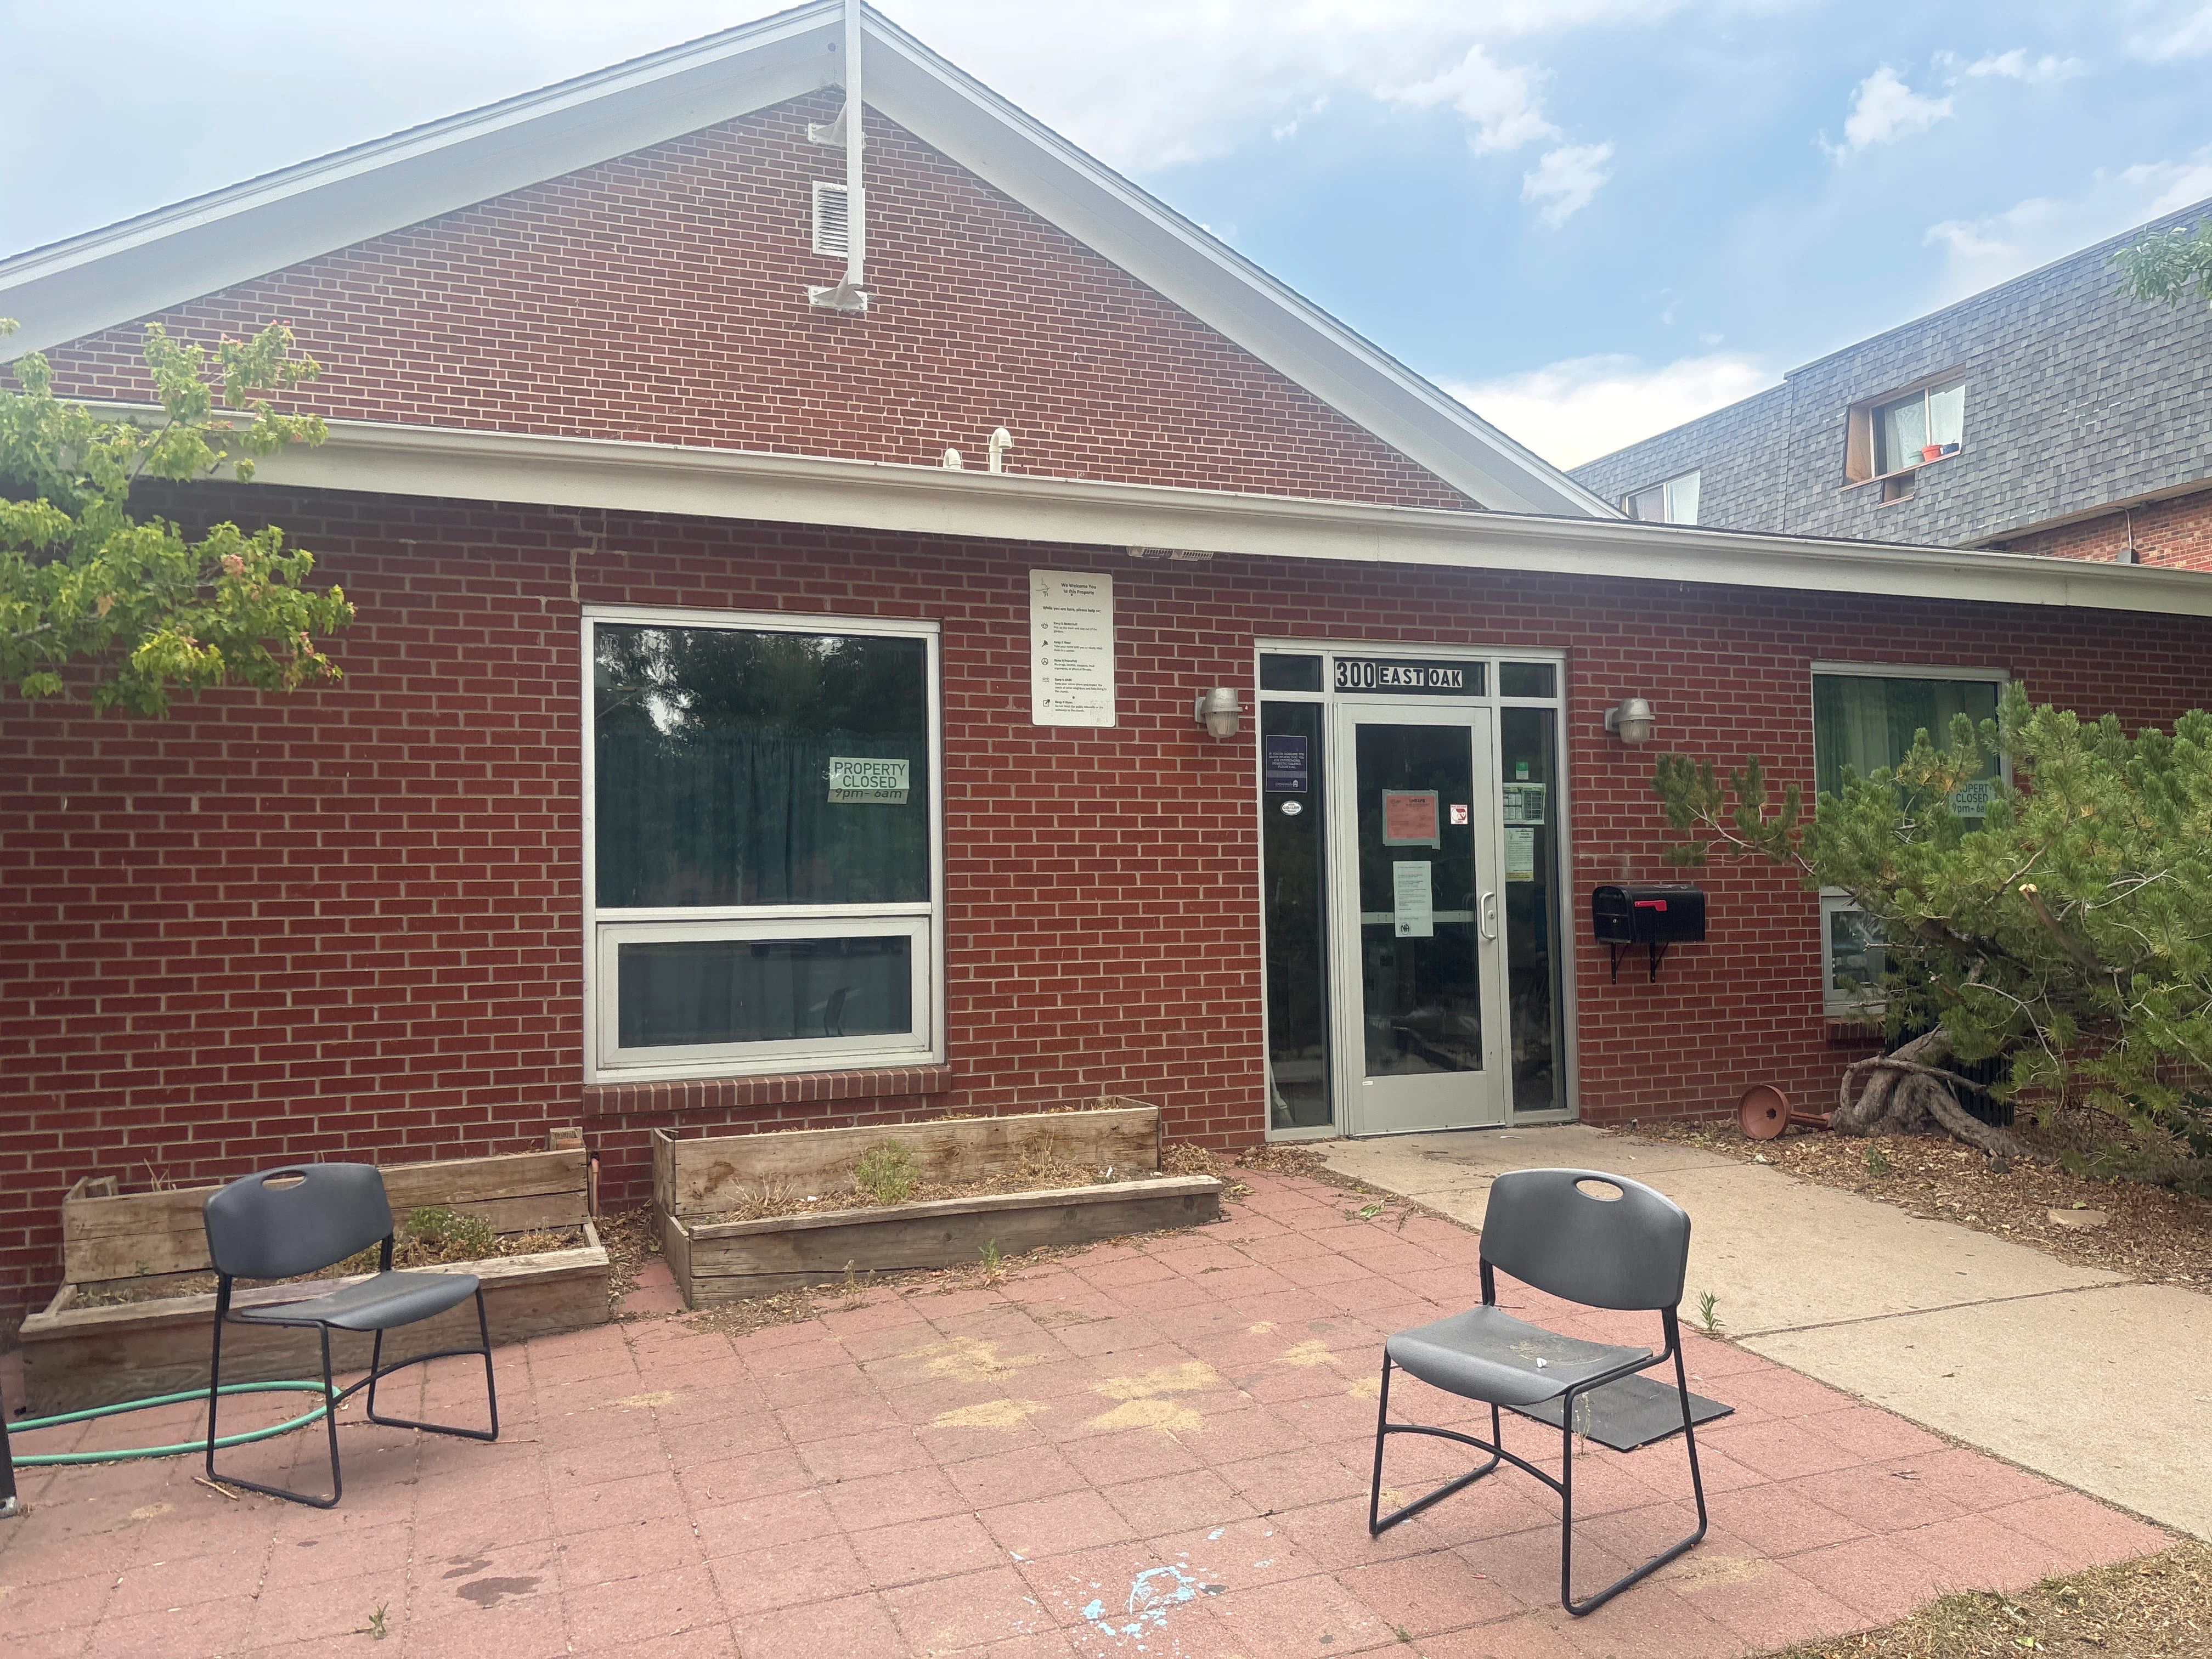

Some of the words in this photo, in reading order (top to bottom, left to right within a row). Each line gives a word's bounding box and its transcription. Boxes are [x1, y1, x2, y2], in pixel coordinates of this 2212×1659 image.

[1337, 662, 1374, 687] 300
[1380, 667, 1423, 685] EAST
[1430, 669, 1461, 686] OAK
[834, 761, 906, 776] PROPERTY
[843, 775, 897, 788] CLOSED
[835, 788, 870, 800] 9pm-
[874, 789, 902, 798] 6am
[1956, 793, 1988, 803] CLOSED
